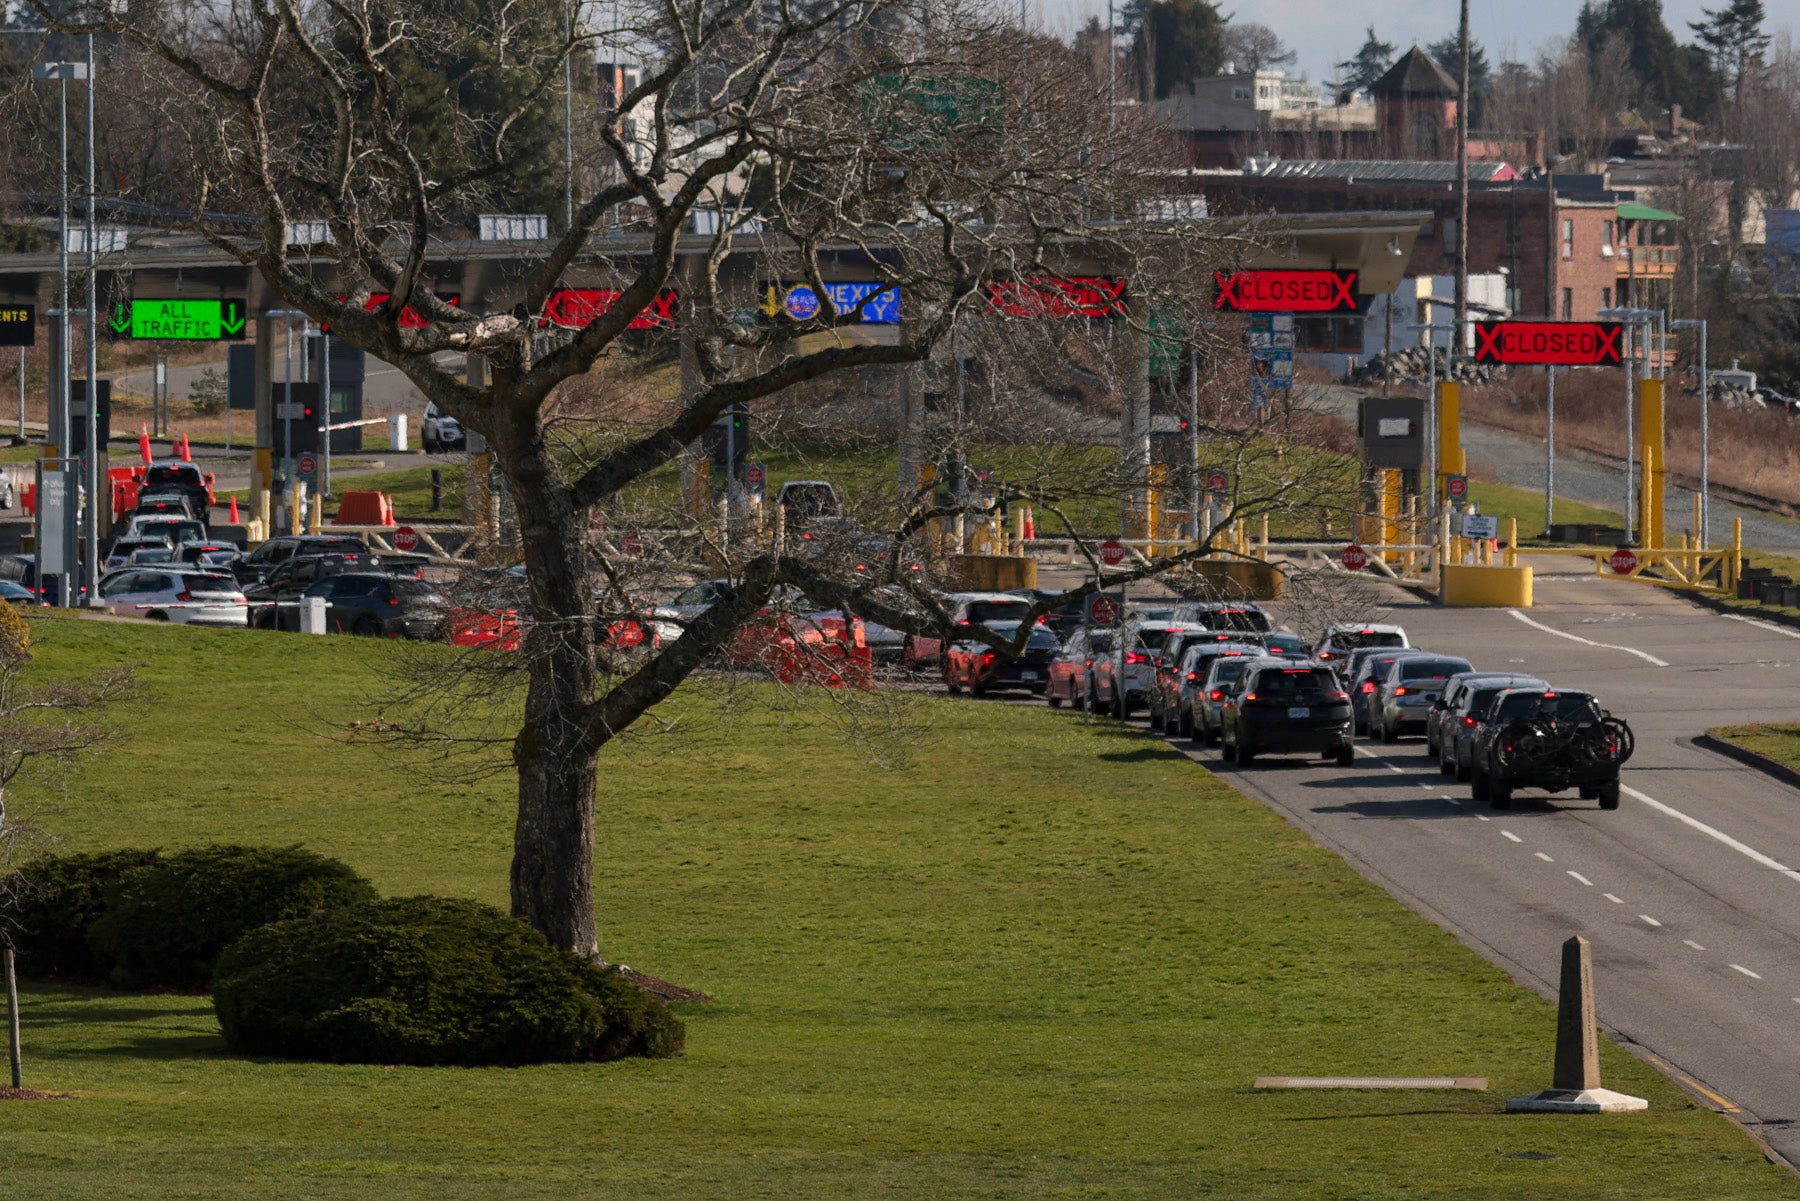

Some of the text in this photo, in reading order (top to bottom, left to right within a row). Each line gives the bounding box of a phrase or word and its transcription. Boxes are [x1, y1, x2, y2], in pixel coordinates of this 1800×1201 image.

[1241, 281, 1330, 301] CLOSED
[161, 303, 192, 319] ALL
[141, 320, 212, 336] TRAFFIC
[1503, 333, 1595, 353] CLOSED
[394, 533, 416, 544] STOP
[1101, 547, 1124, 558] STOP
[1343, 552, 1365, 563] STOP
[1612, 556, 1635, 568] STOP
